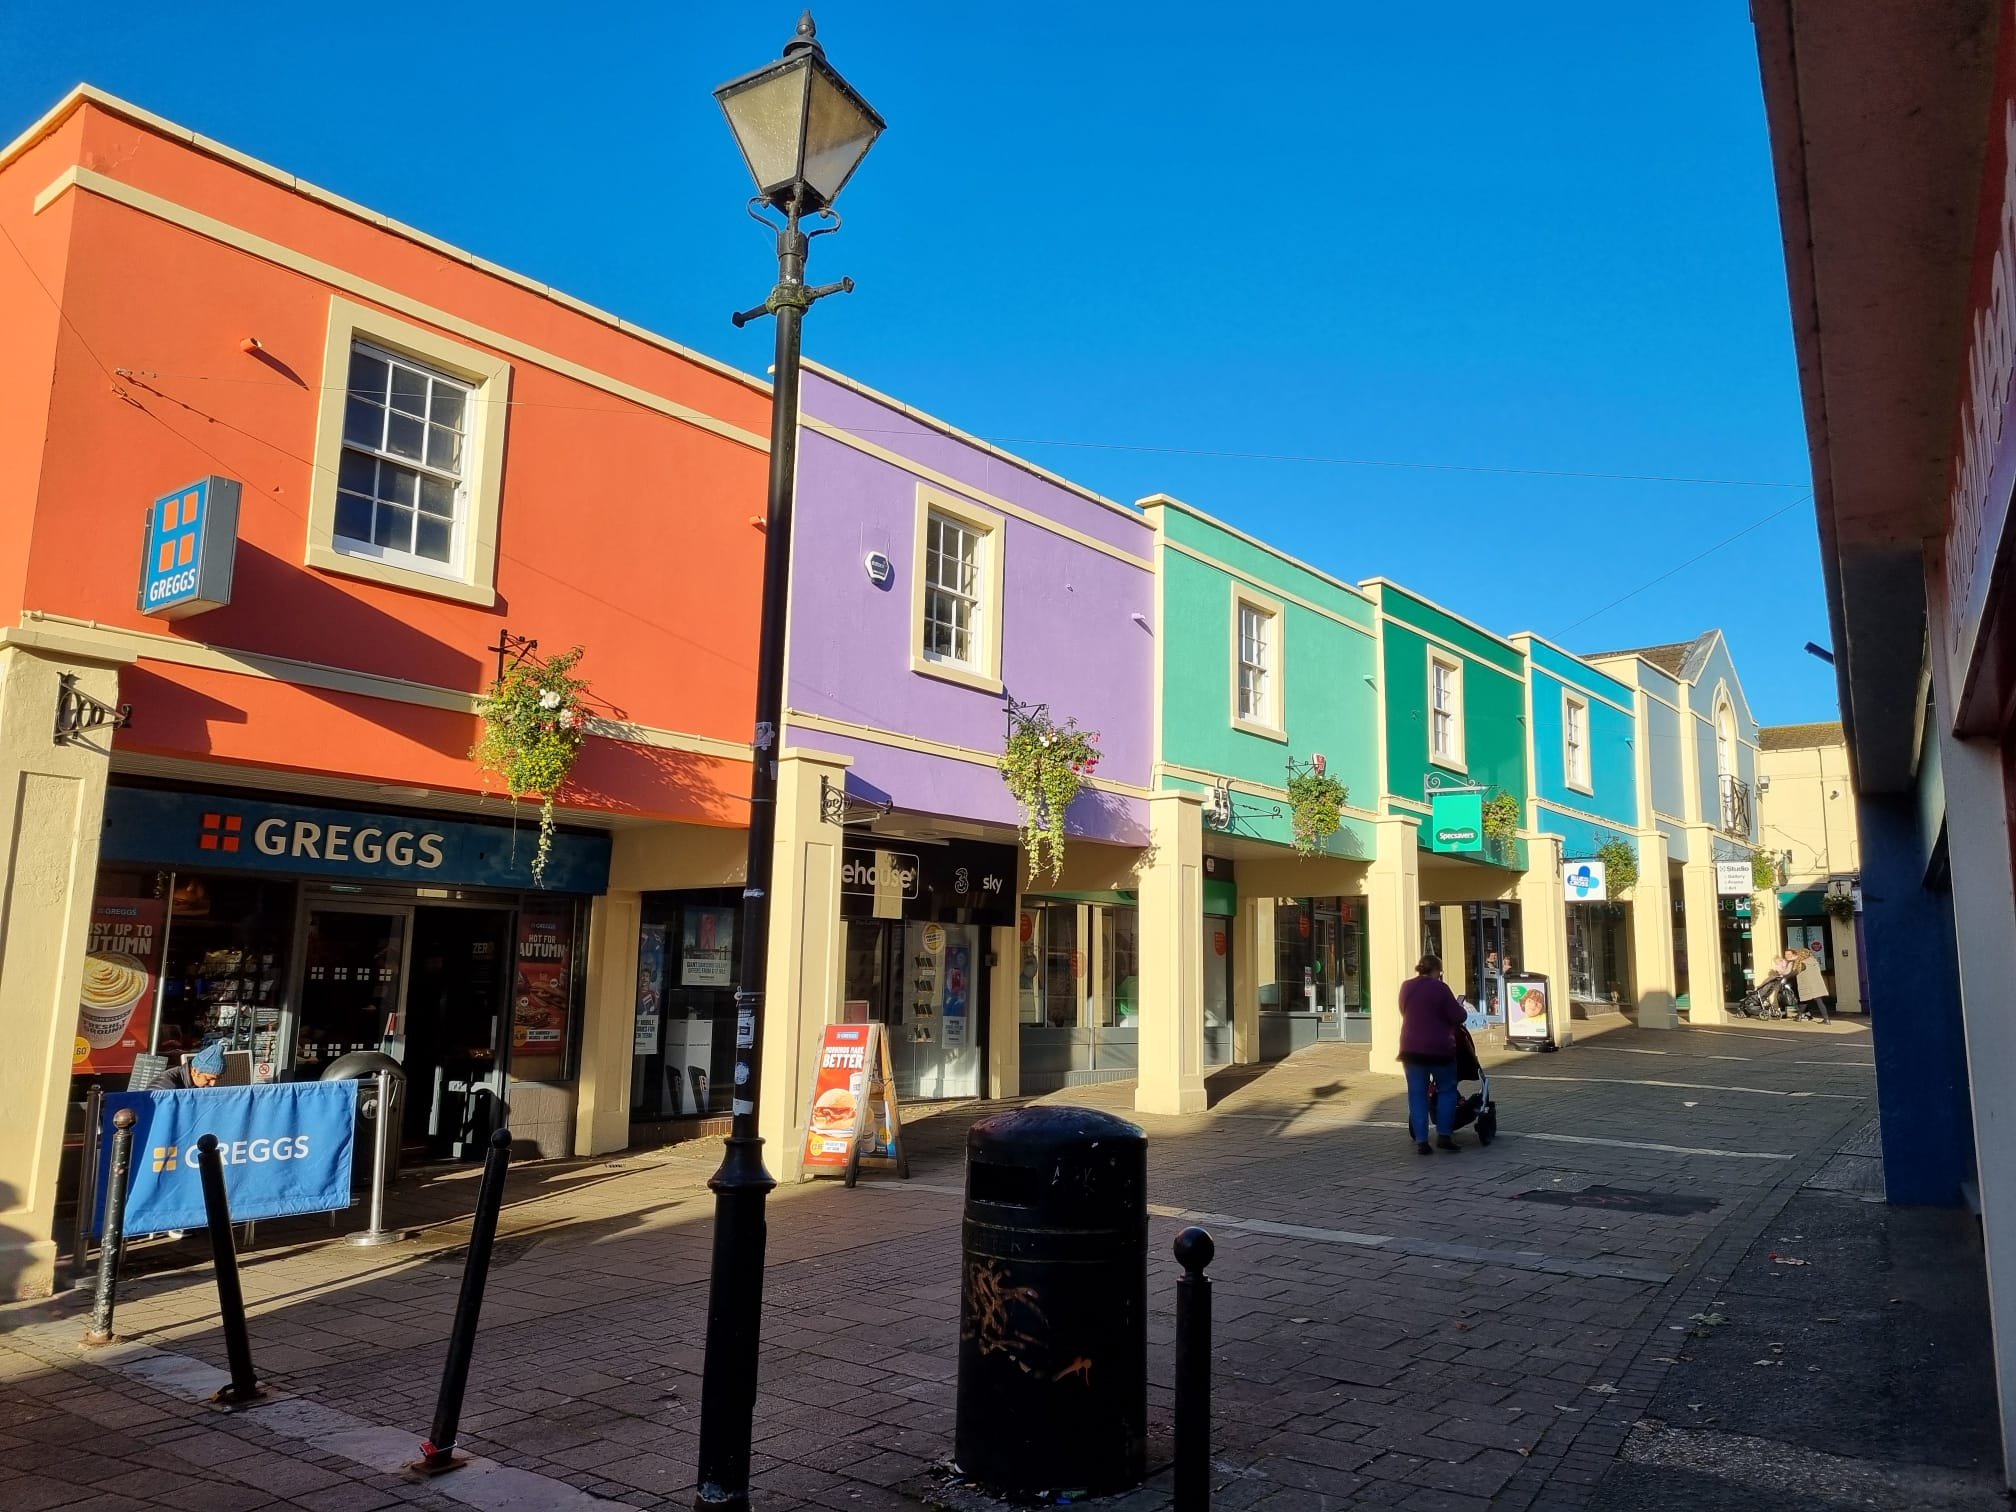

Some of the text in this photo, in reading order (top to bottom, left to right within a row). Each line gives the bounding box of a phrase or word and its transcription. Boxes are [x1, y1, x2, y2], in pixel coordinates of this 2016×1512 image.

[150, 568, 196, 602] GREGGS
[254, 818, 445, 869] GREGGS
[1439, 831, 1475, 841] Specsavers
[982, 874, 1003, 894] sky
[105, 908, 137, 916] GREGGS
[115, 923, 133, 936] UP
[136, 924, 153, 937] TO
[528, 934, 556, 944] HOT FOR
[519, 942, 564, 959] AUTUMN
[823, 1053, 864, 1069] BETTER
